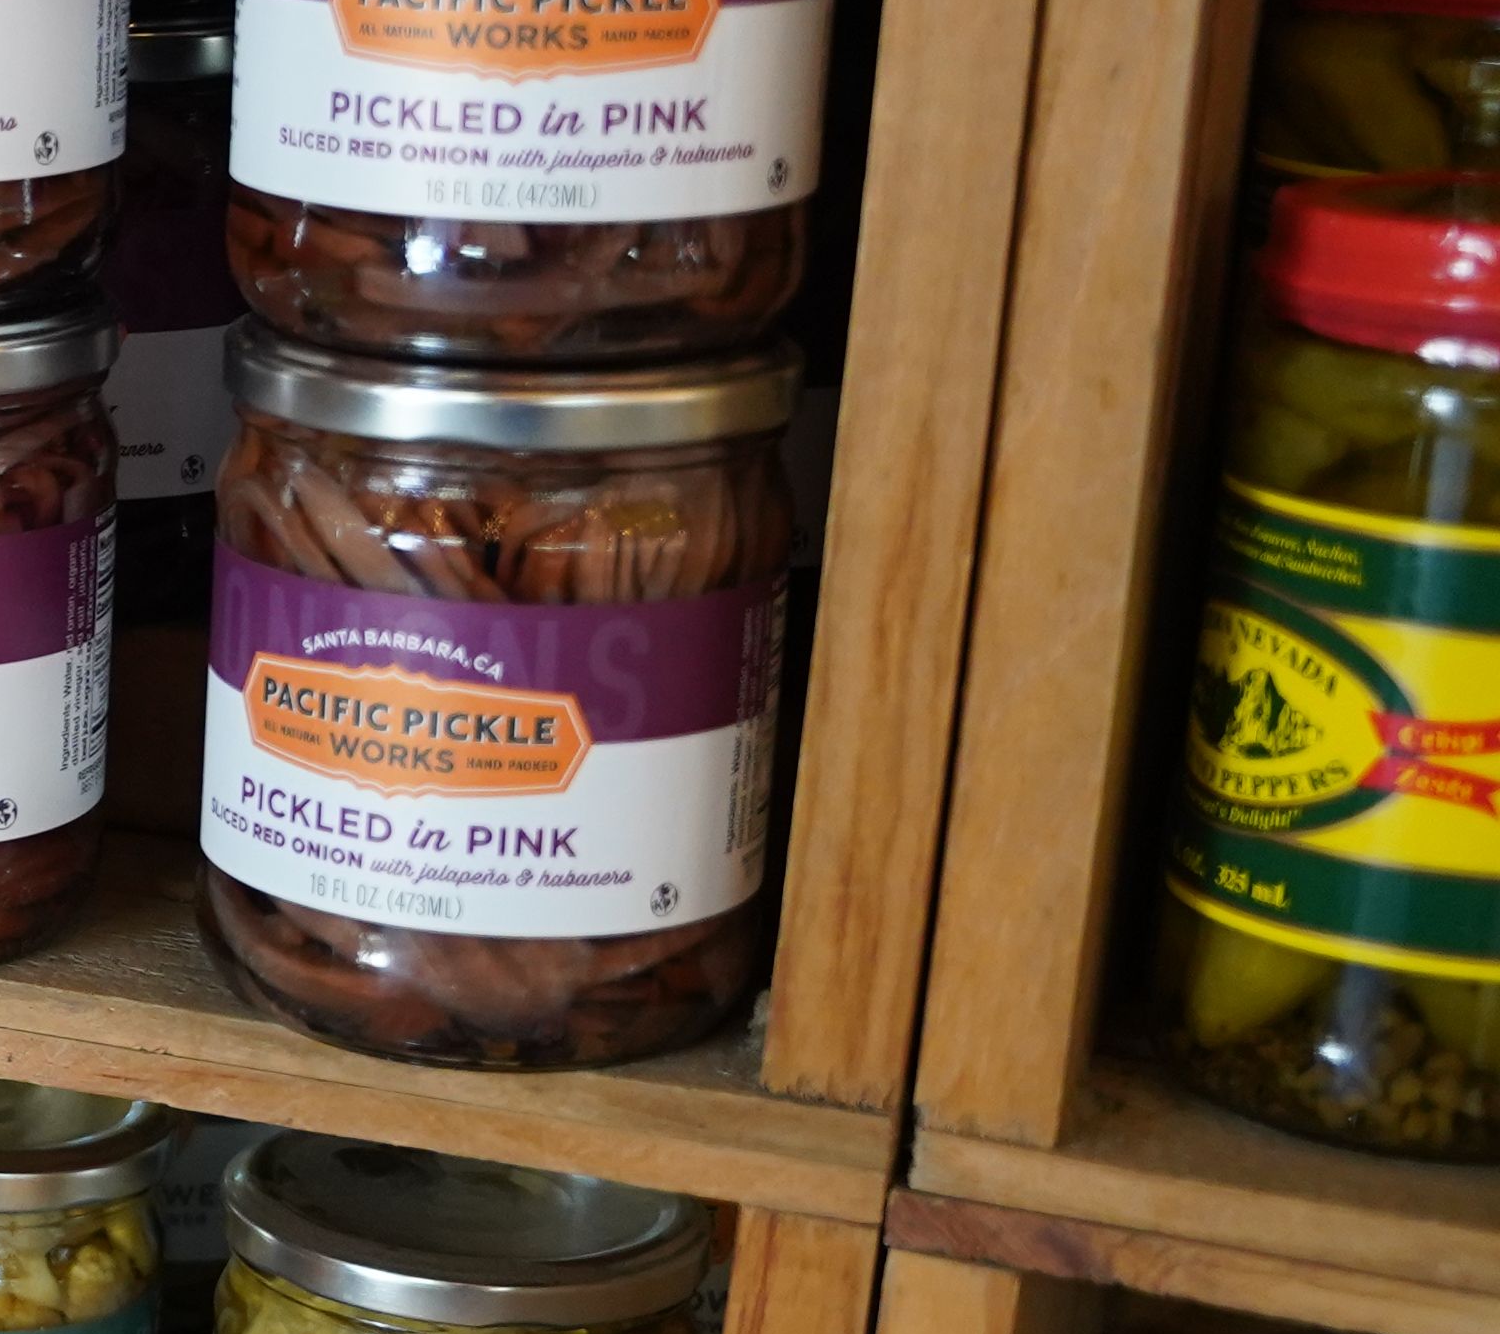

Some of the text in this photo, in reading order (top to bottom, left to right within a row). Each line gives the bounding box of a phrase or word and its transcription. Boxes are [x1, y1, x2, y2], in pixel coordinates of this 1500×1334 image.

[447, 23, 589, 51] WORKS
[329, 91, 711, 136] PICKLED in PINK
[262, 677, 556, 746] PACIFIC PICKLE
[327, 732, 455, 774] WORKS
[241, 775, 579, 859] PICKLED in PINK
